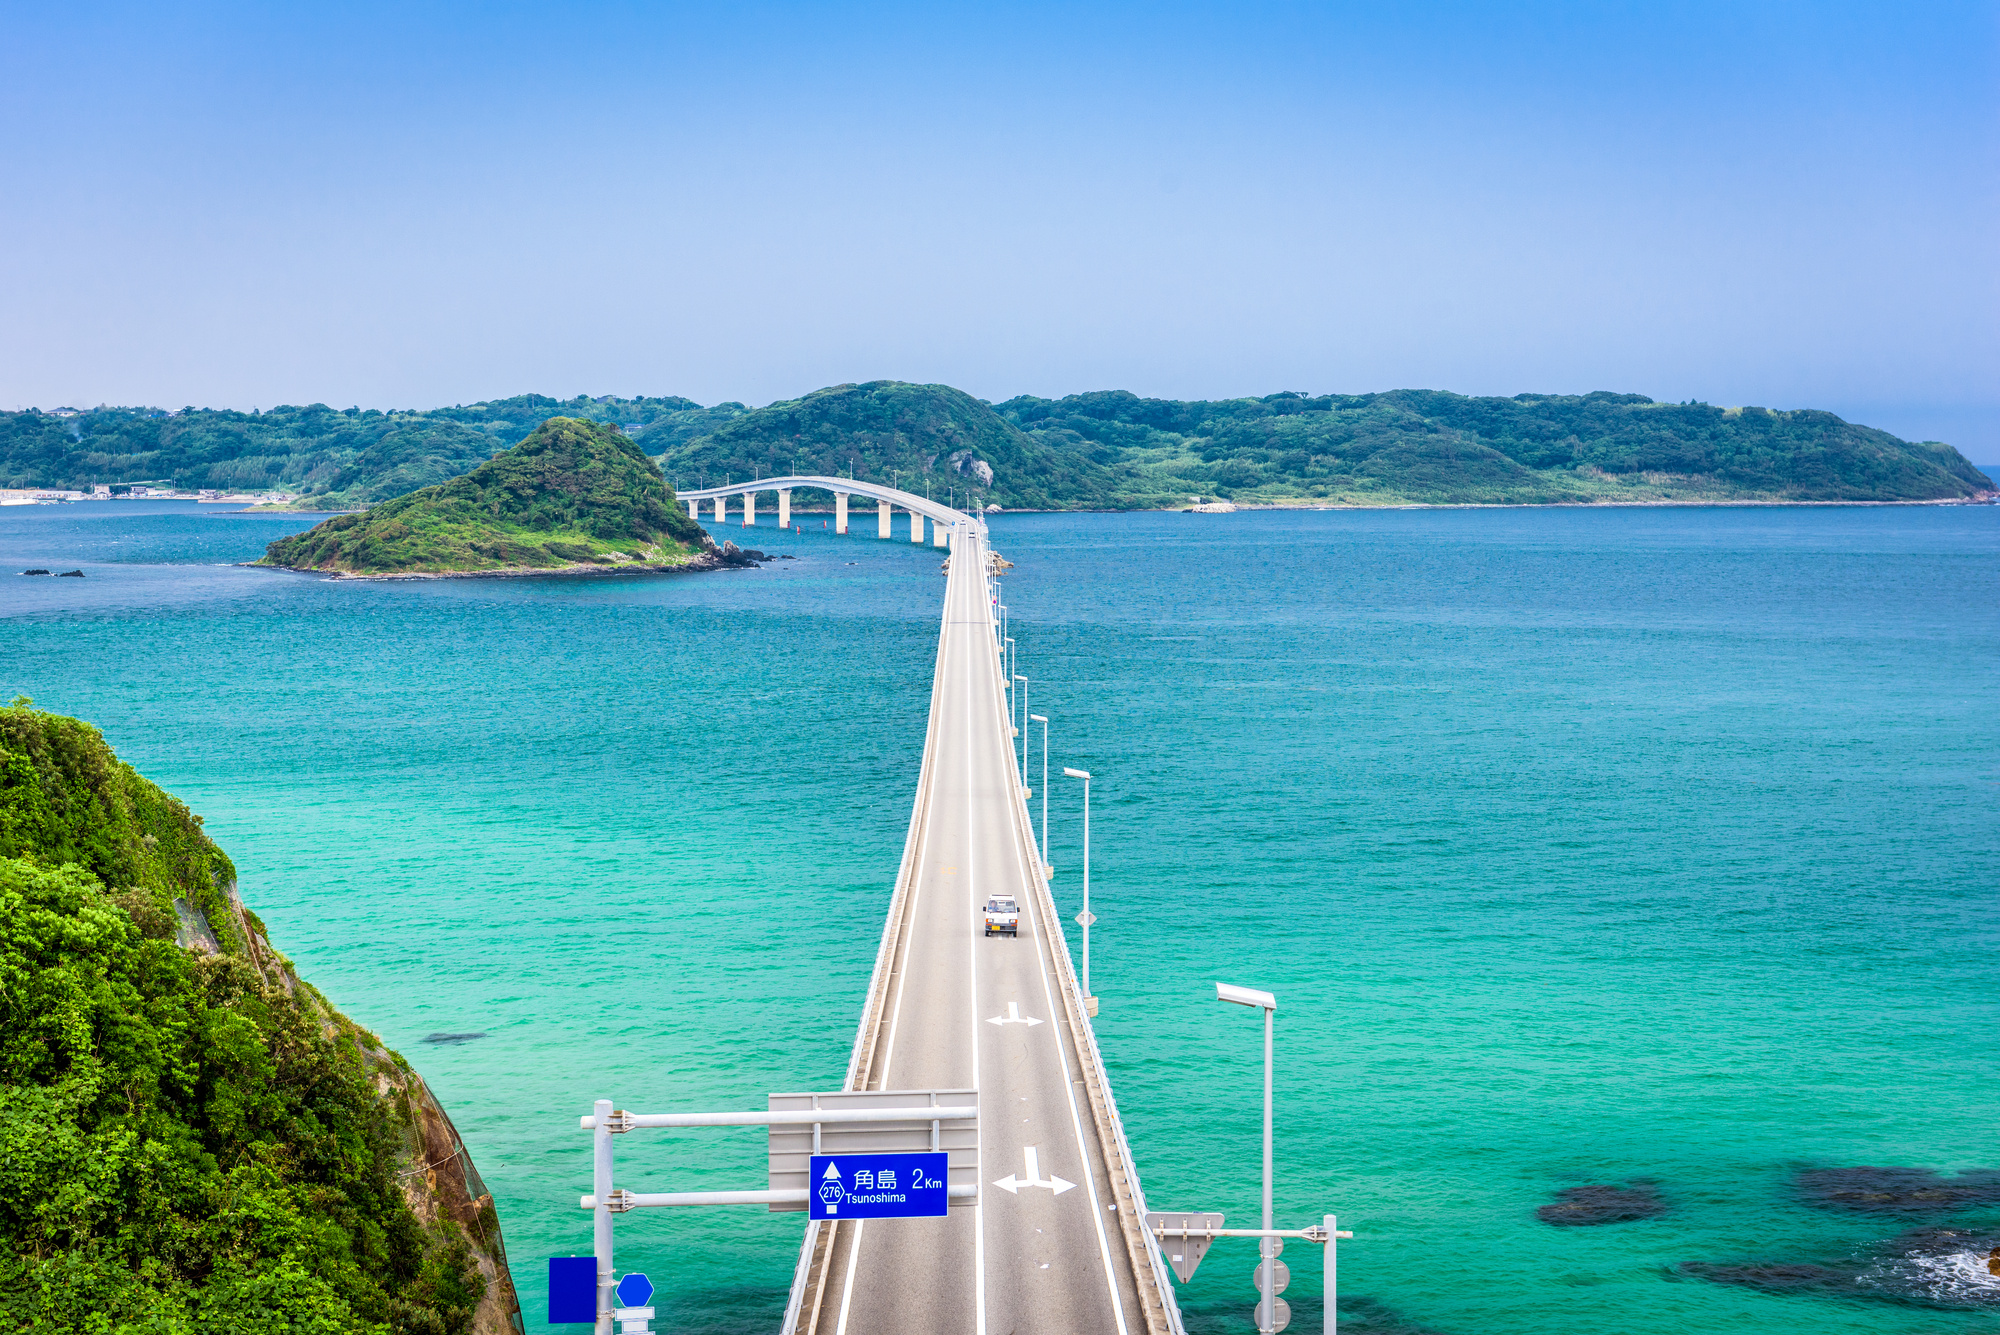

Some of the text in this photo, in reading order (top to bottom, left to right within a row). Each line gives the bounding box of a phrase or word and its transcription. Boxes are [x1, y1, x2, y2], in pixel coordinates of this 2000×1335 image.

[854, 1169, 897, 1190] 角島
[823, 1186, 841, 1199] 276
[845, 1192, 906, 1204] Tsunoshima
